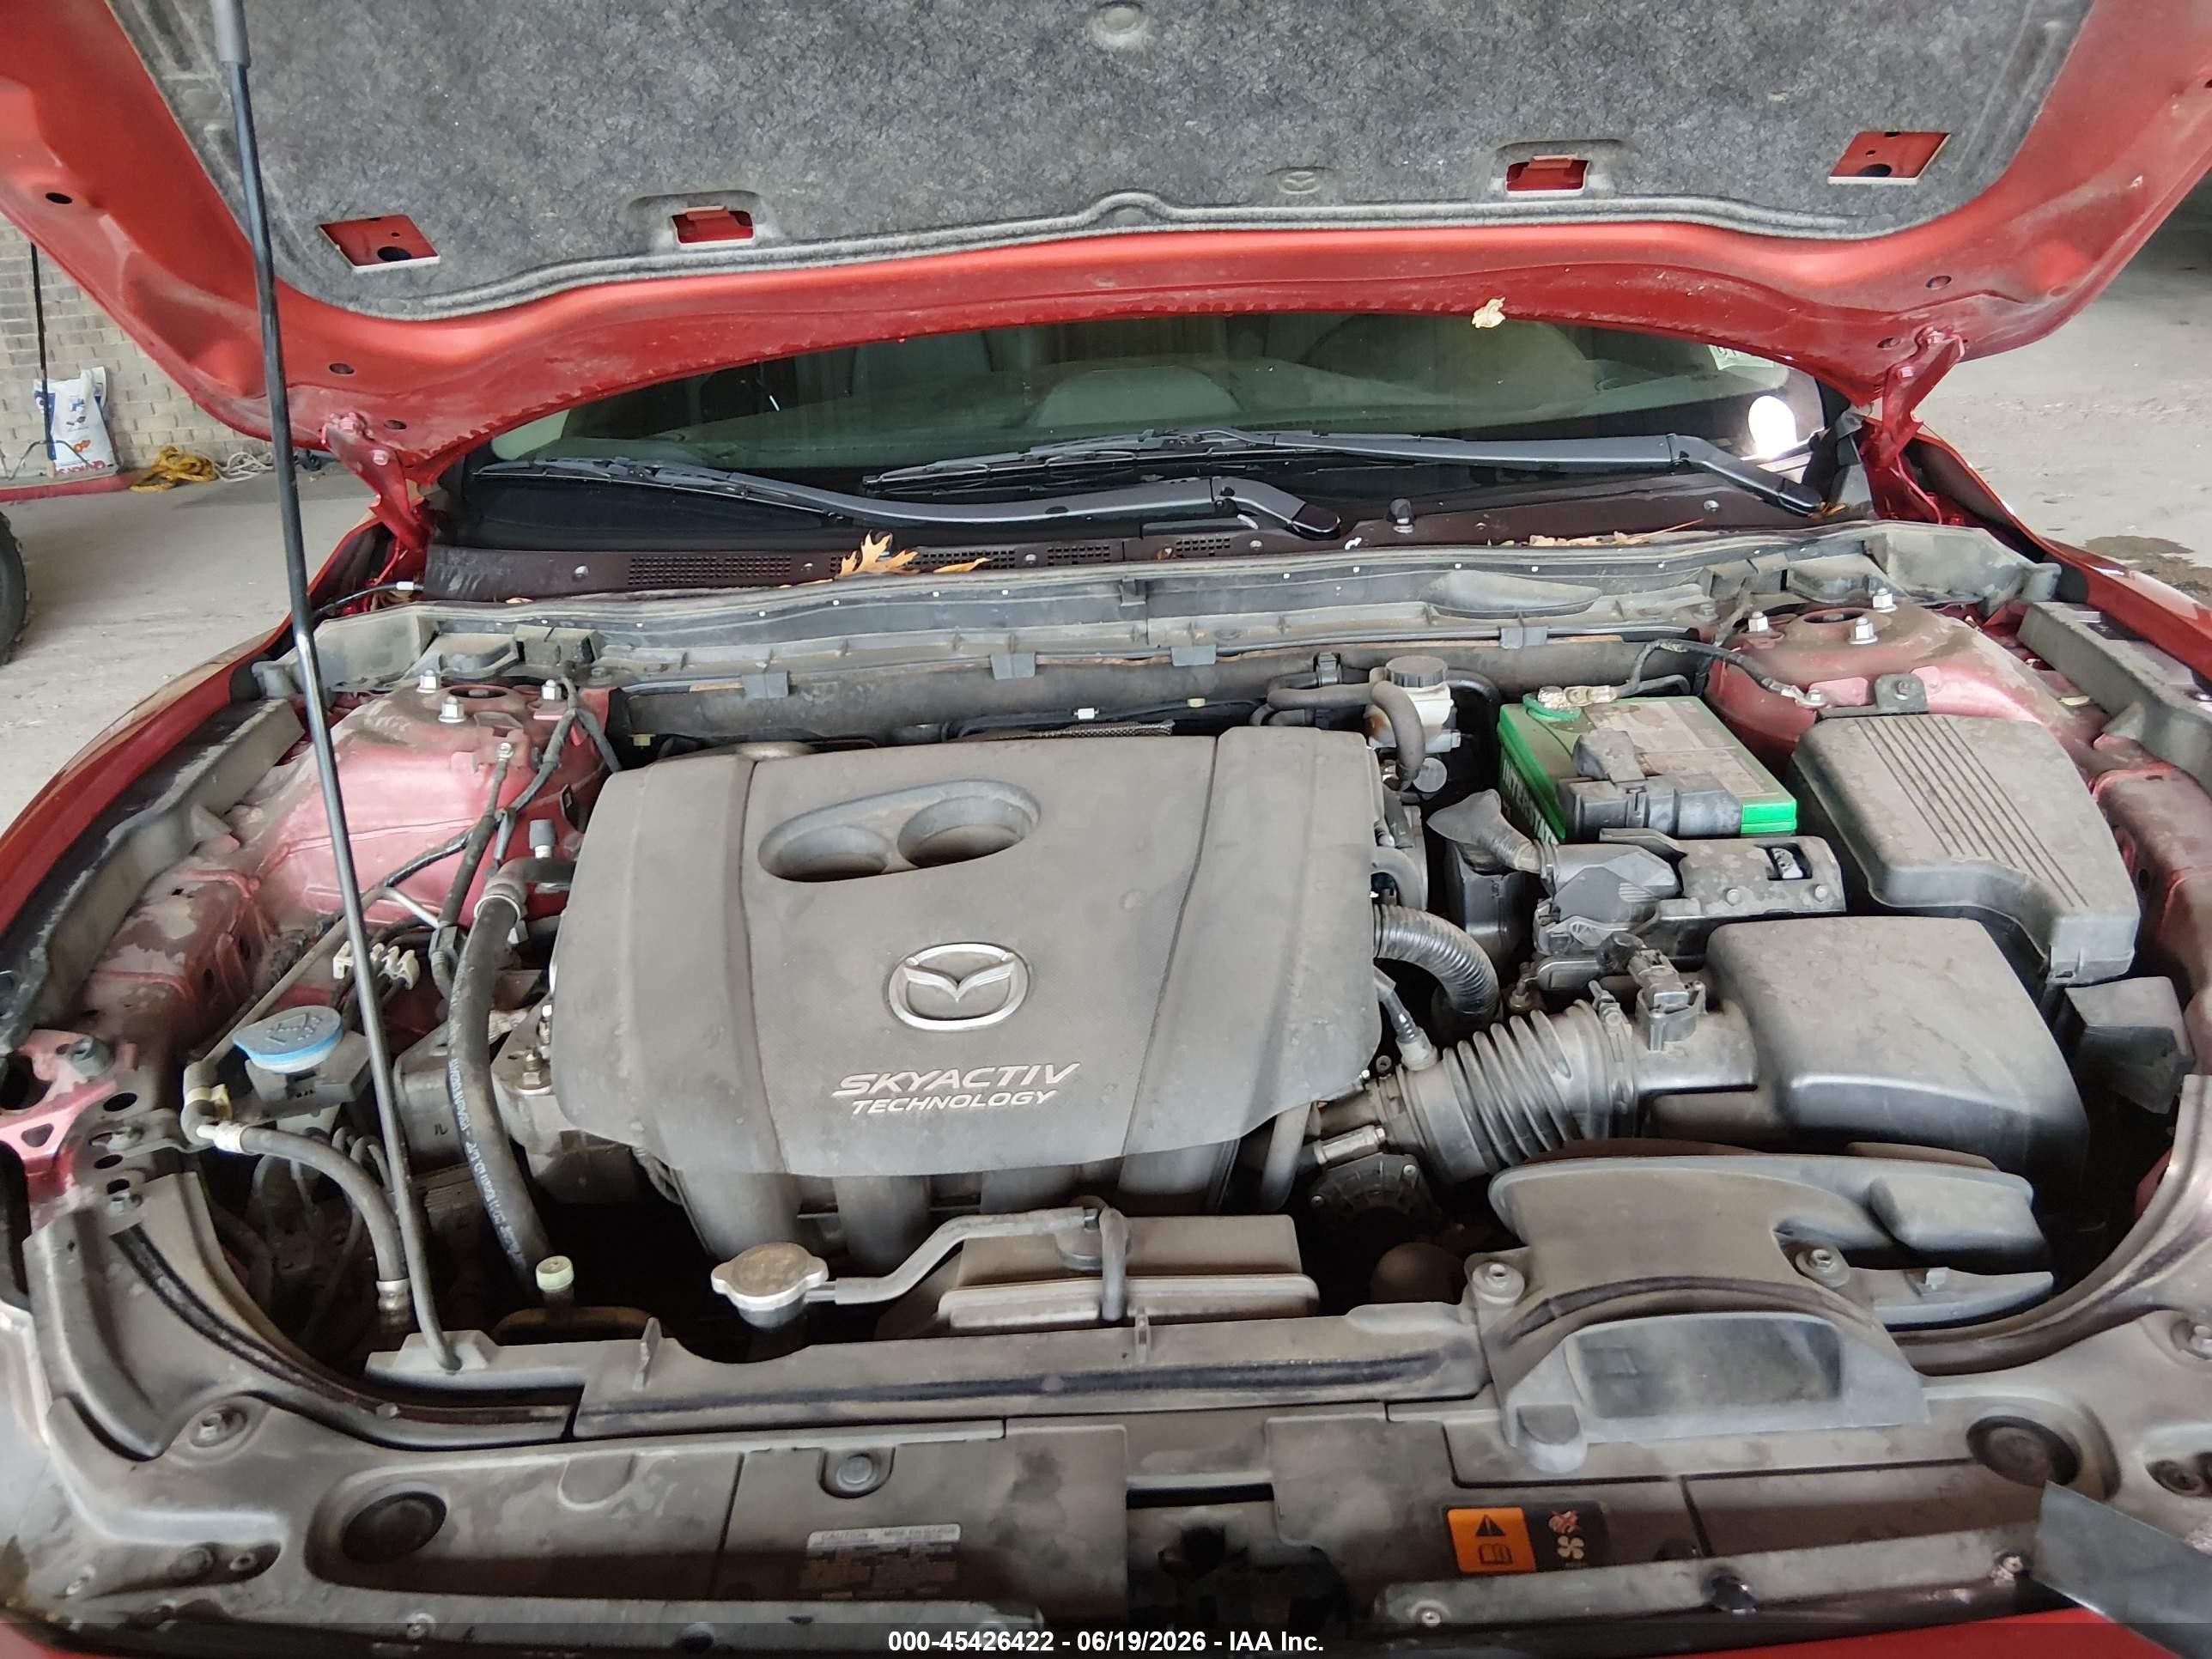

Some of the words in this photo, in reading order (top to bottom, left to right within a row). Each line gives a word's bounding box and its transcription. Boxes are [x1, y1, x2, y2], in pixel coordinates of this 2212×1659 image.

[831, 1063, 1080, 1097] SKYACTIV
[851, 1090, 1058, 1115] TECHNOLOGY
[821, 1531, 868, 1540] CAUTION
